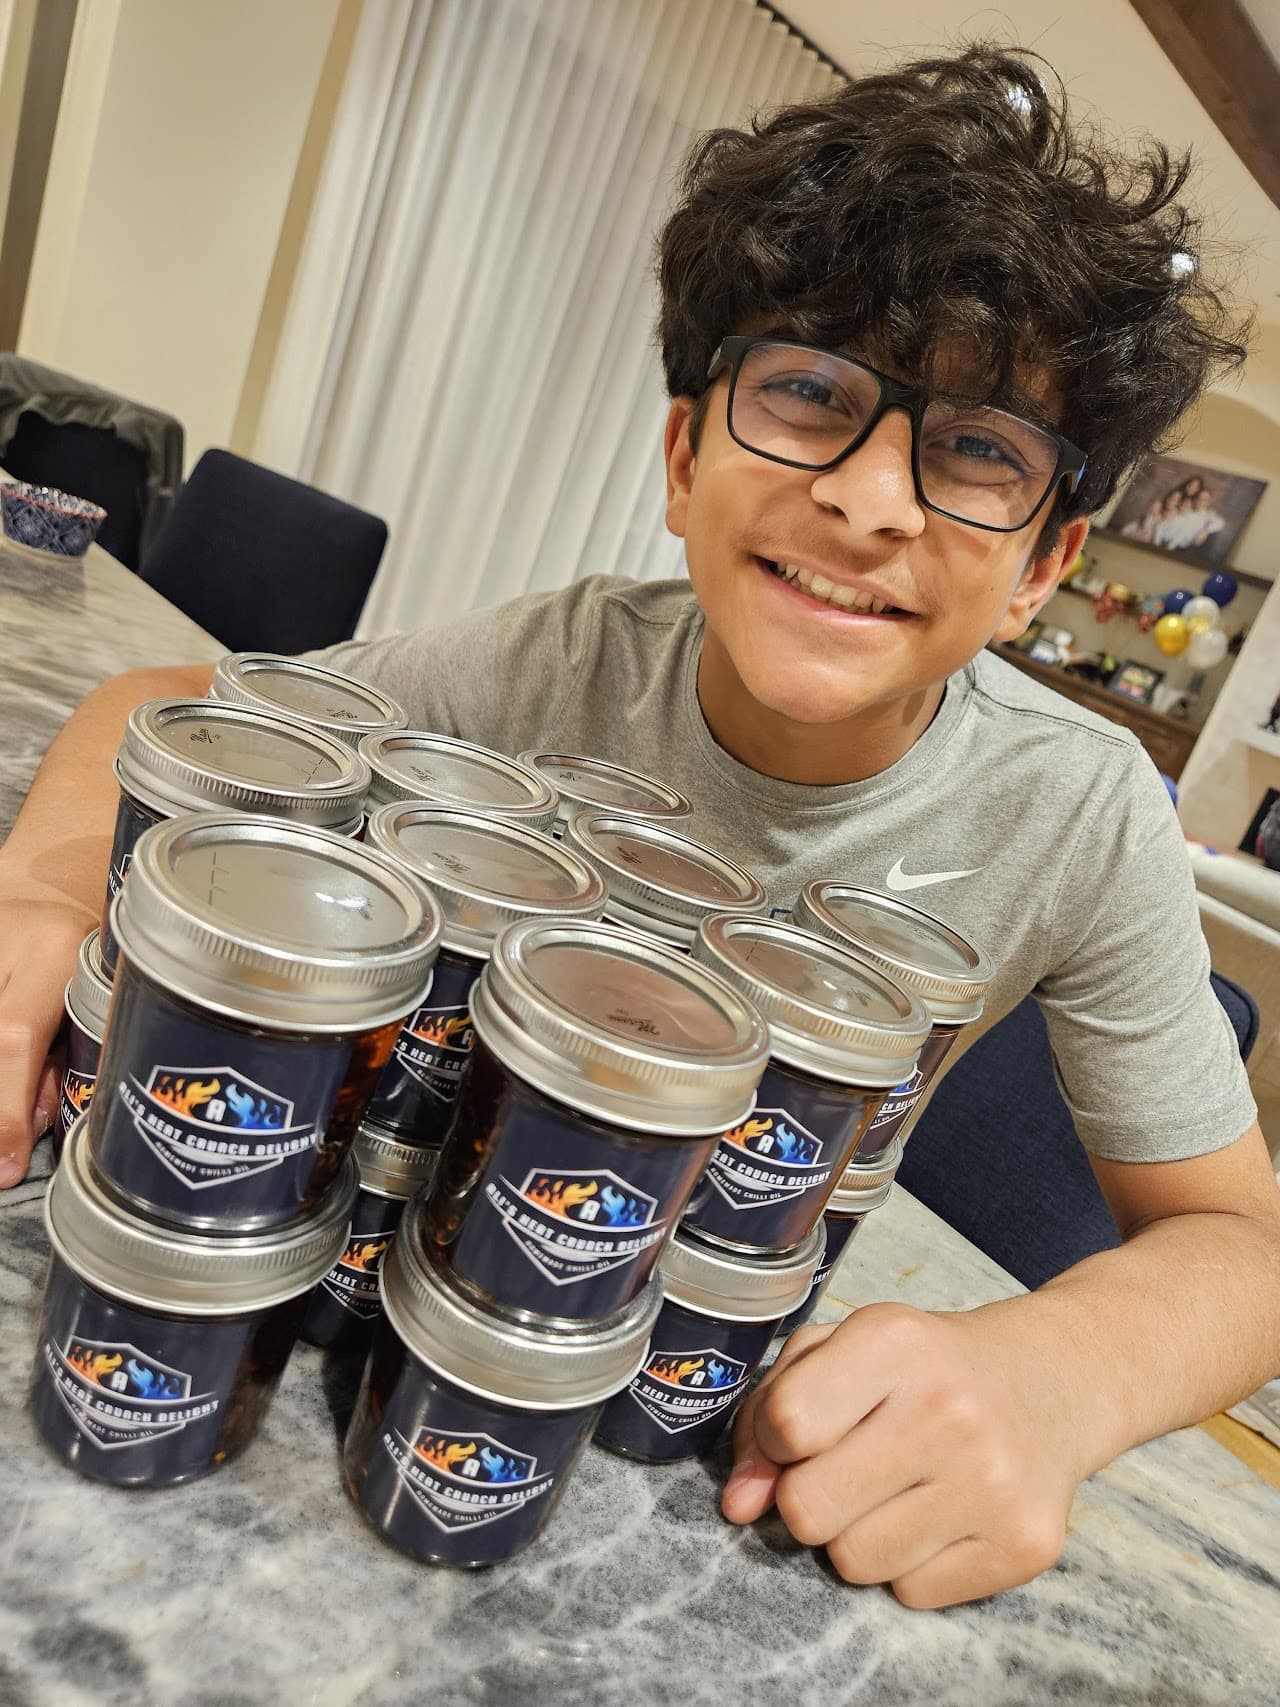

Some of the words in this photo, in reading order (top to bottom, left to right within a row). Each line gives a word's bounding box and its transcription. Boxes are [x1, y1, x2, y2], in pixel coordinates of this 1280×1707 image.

[118, 1080, 146, 1116] ALI'S
[149, 1112, 184, 1142] HEAT
[185, 1134, 250, 1155] CRUNCH
[255, 1132, 318, 1156] DELIGHT
[205, 1099, 227, 1122] A
[757, 1134, 775, 1153] A
[712, 1150, 736, 1167] EAT
[737, 1163, 785, 1185] CRUNCH
[788, 1171, 831, 1186] DELIGHT
[485, 1182, 517, 1217] ALI'S
[519, 1213, 554, 1240] HEAT
[556, 1233, 615, 1252] CRUNCH
[616, 1227, 667, 1251] DELIGHT
[579, 1200, 600, 1221] A
[329, 1270, 358, 1287] HEAT
[111, 1371, 129, 1392] A
[690, 1371, 706, 1385] A
[63, 1377, 93, 1404] HEAT
[95, 1400, 152, 1422] CRUNCH
[157, 1400, 219, 1422] DELIGHT
[642, 1386, 670, 1402] HEAT
[672, 1397, 714, 1407] CRUNCH
[461, 1458, 480, 1477] A
[410, 1465, 443, 1491] HEAT
[444, 1487, 498, 1504] CRUNCH
[502, 1478, 555, 1502] DELIGHT
